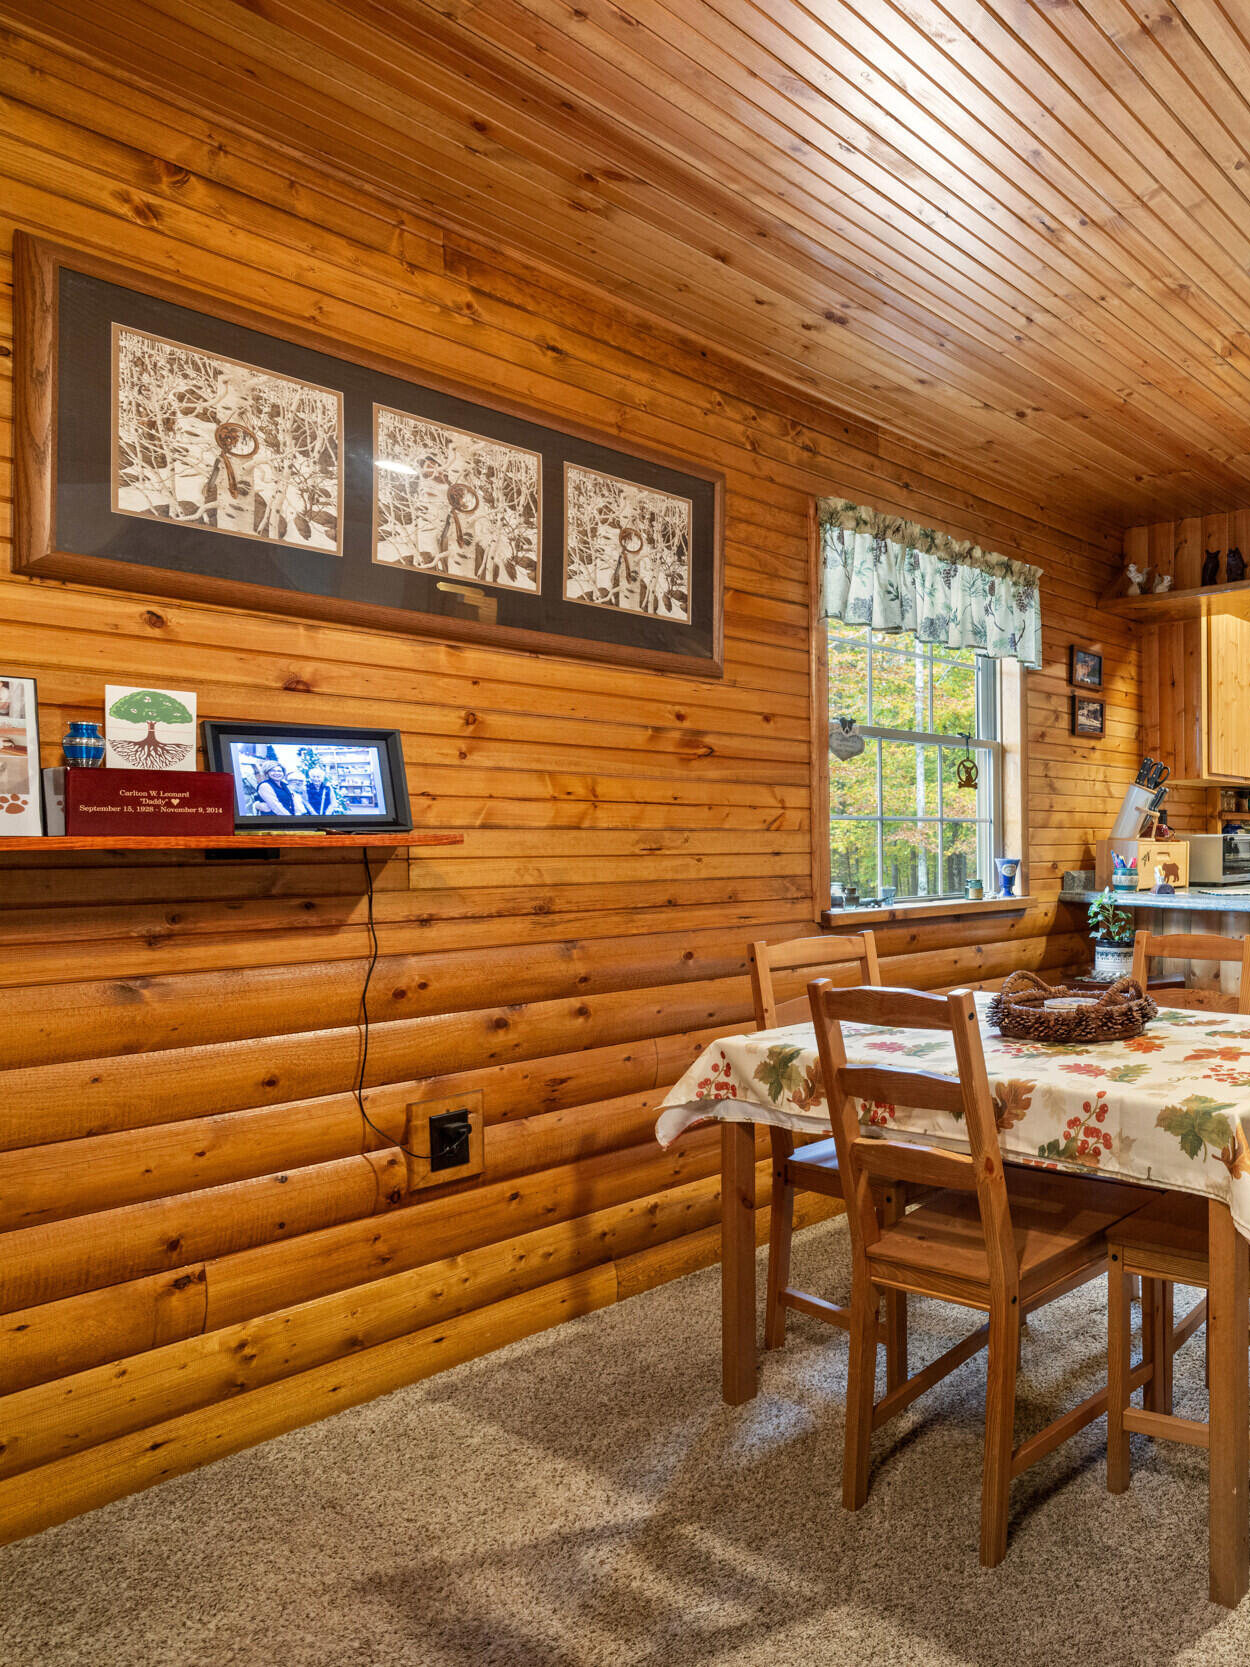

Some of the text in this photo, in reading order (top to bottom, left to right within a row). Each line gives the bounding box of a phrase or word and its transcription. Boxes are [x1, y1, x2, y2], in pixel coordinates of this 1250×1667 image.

[119, 789, 148, 797] Carlton
[160, 790, 190, 798] Leonard
[79, 804, 121, 813] September
[123, 805, 135, 813] 15,
